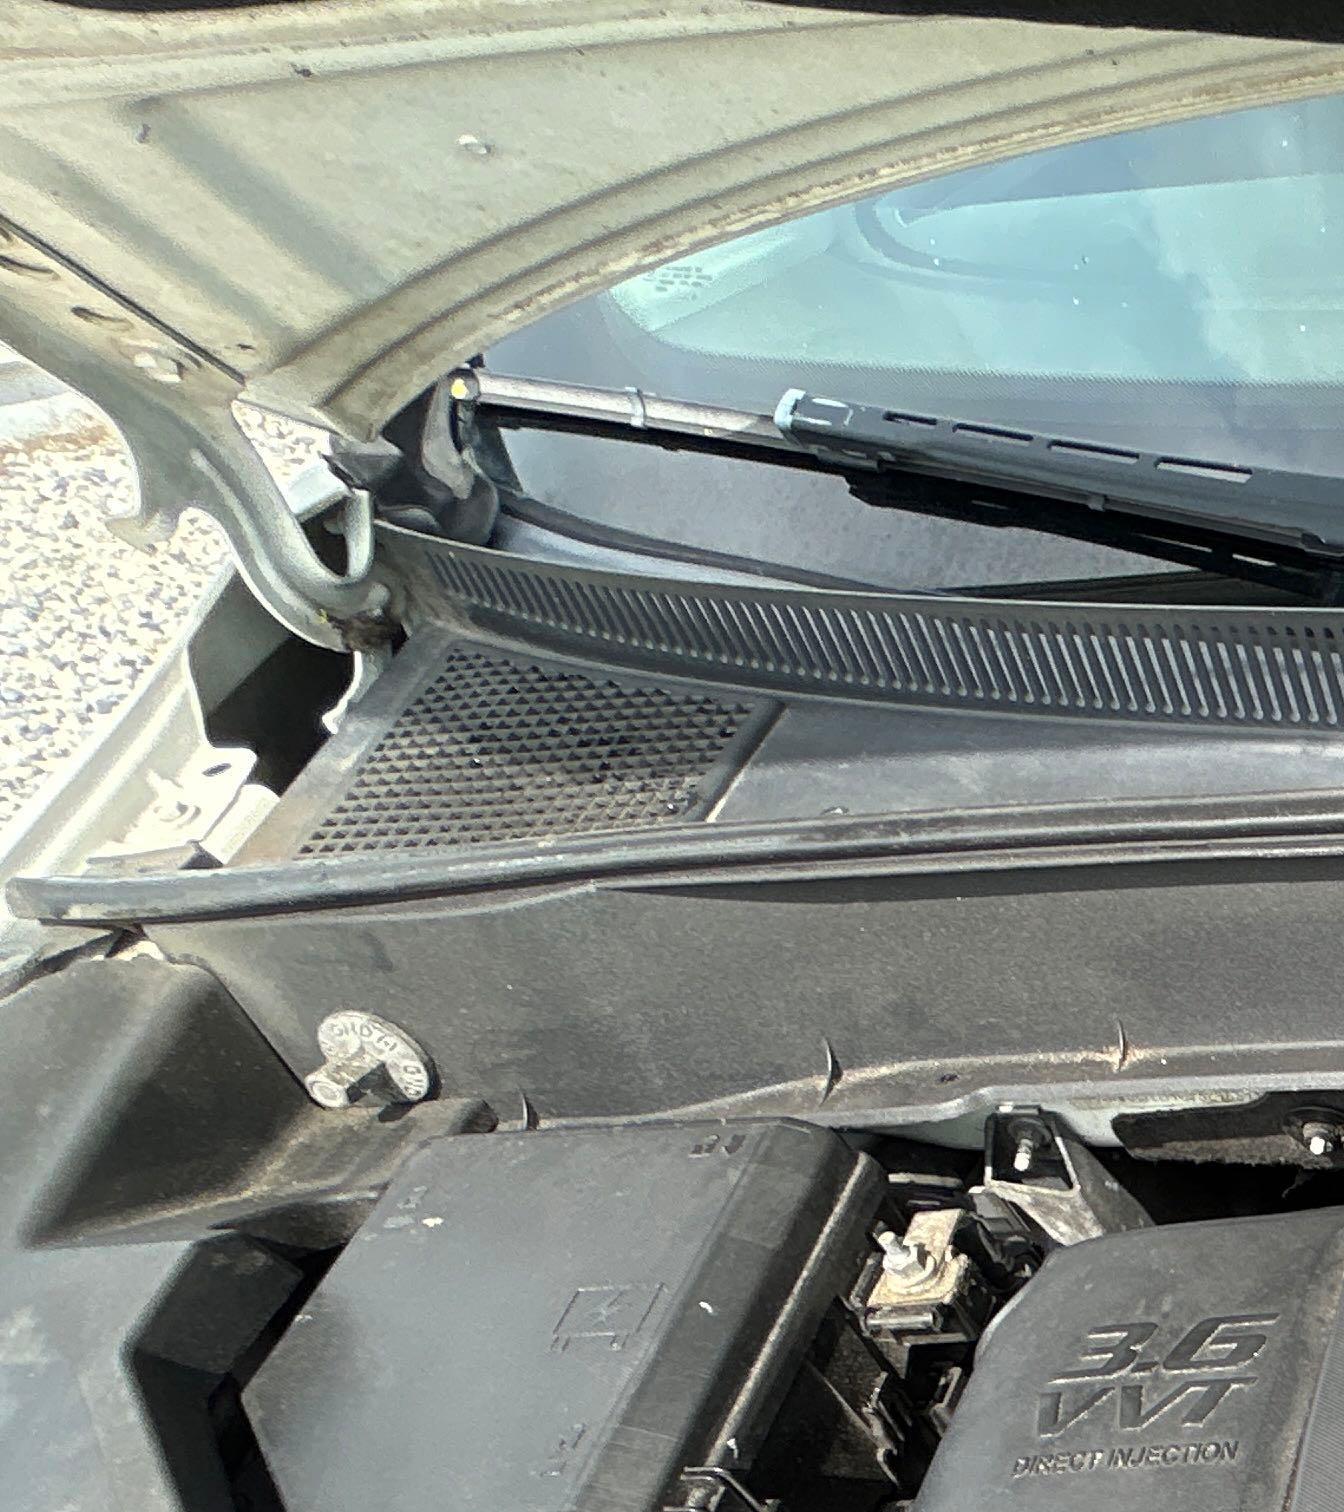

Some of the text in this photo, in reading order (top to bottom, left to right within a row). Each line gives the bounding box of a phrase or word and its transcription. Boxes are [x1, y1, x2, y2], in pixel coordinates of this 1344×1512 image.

[1047, 1313, 1281, 1384] 3.6
[1037, 1375, 1259, 1438] VVT
[1012, 1440, 1240, 1479] DIRECT INJECTION
